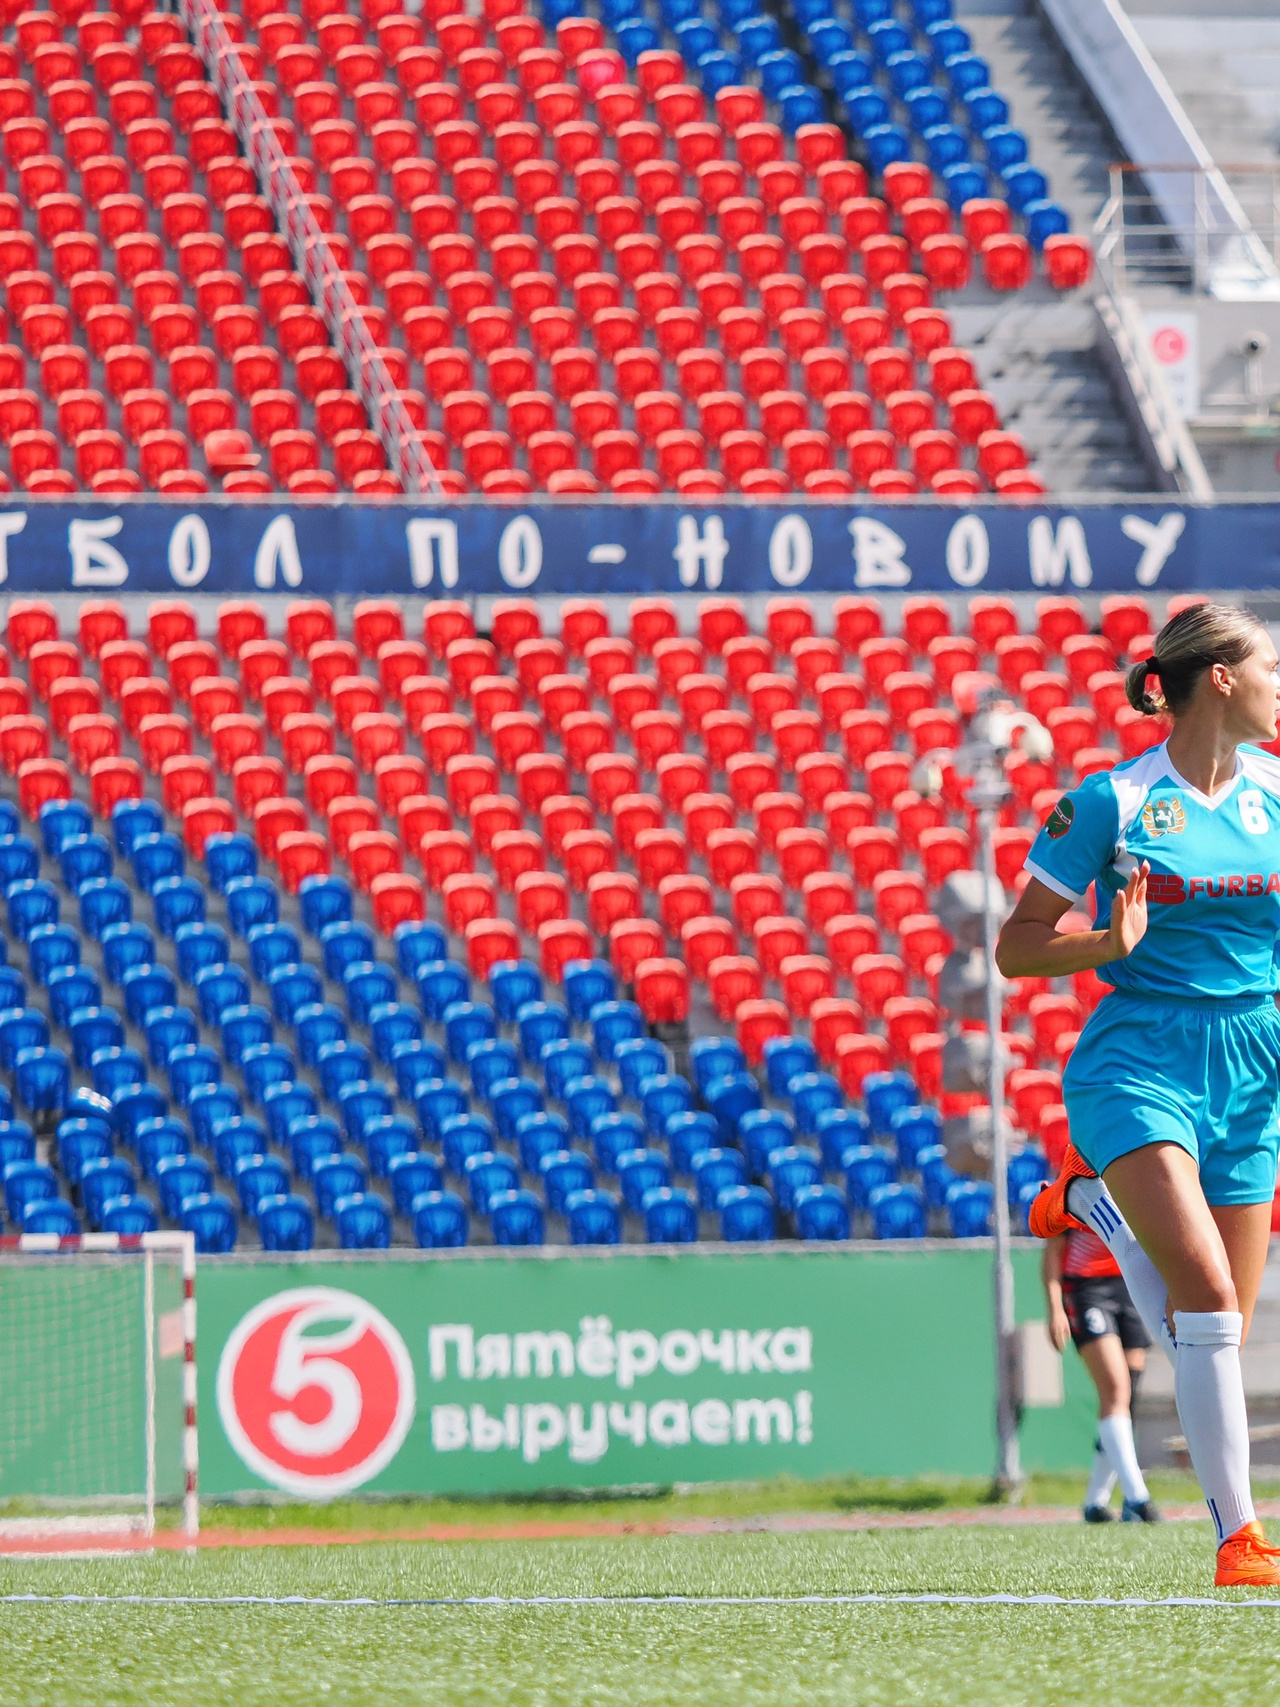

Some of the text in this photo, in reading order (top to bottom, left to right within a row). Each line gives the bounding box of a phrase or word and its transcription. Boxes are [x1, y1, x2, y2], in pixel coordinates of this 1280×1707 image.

[406, 512, 1186, 590] ПО-НОВОМУ
[1237, 789, 1270, 835] 6
[268, 1302, 364, 1458] 5
[428, 1314, 814, 1388] Пятёрочка
[430, 1389, 814, 1462] выручает!
